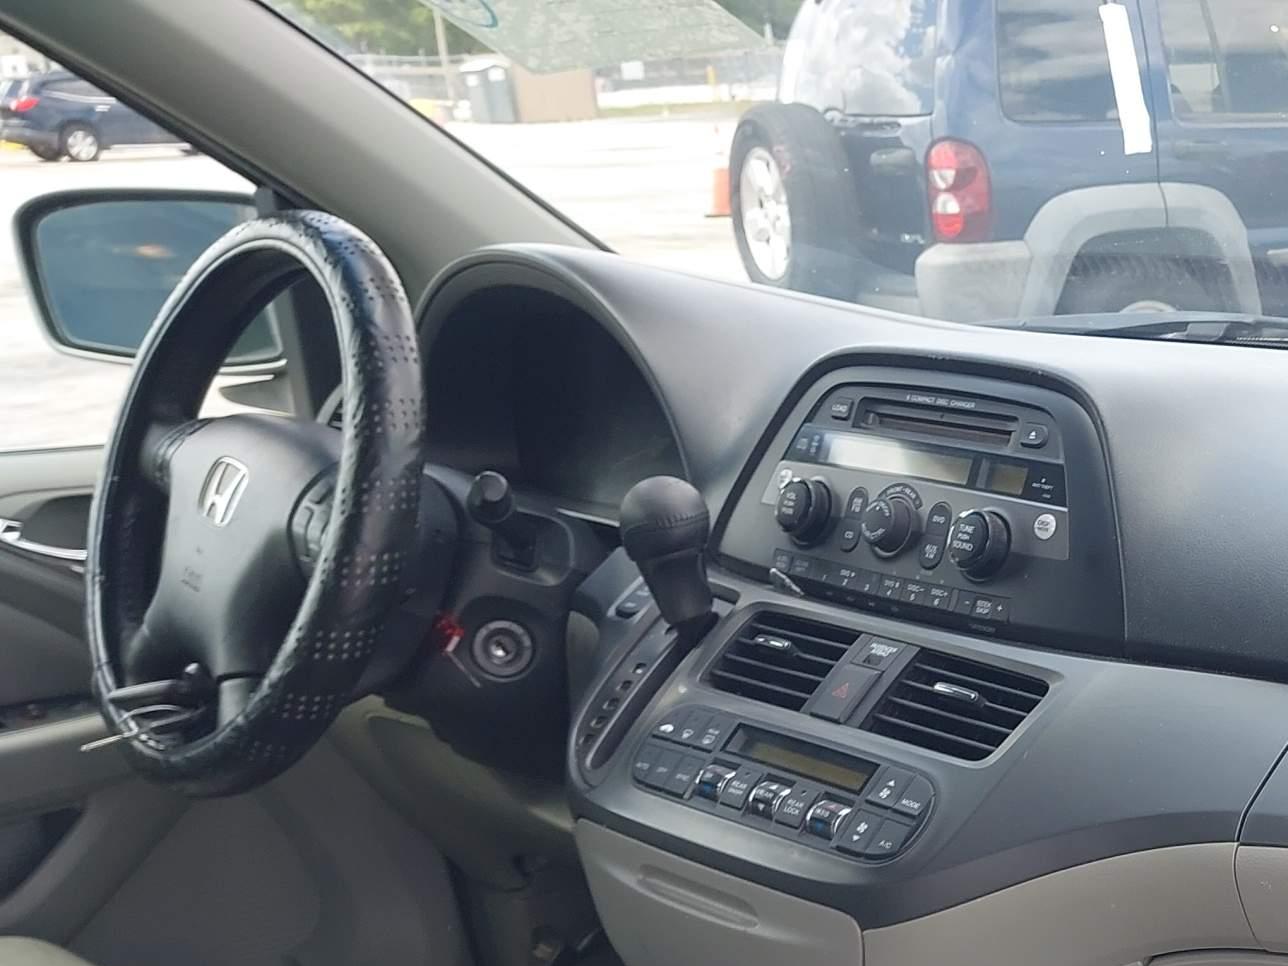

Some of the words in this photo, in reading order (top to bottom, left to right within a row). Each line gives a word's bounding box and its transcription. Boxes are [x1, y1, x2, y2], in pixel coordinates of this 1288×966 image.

[959, 523, 976, 533] TUNE
[952, 540, 974, 551] SOUND
[901, 798, 921, 809] MODE
[783, 806, 800, 815] LOCK
[878, 839, 893, 849] A/C
